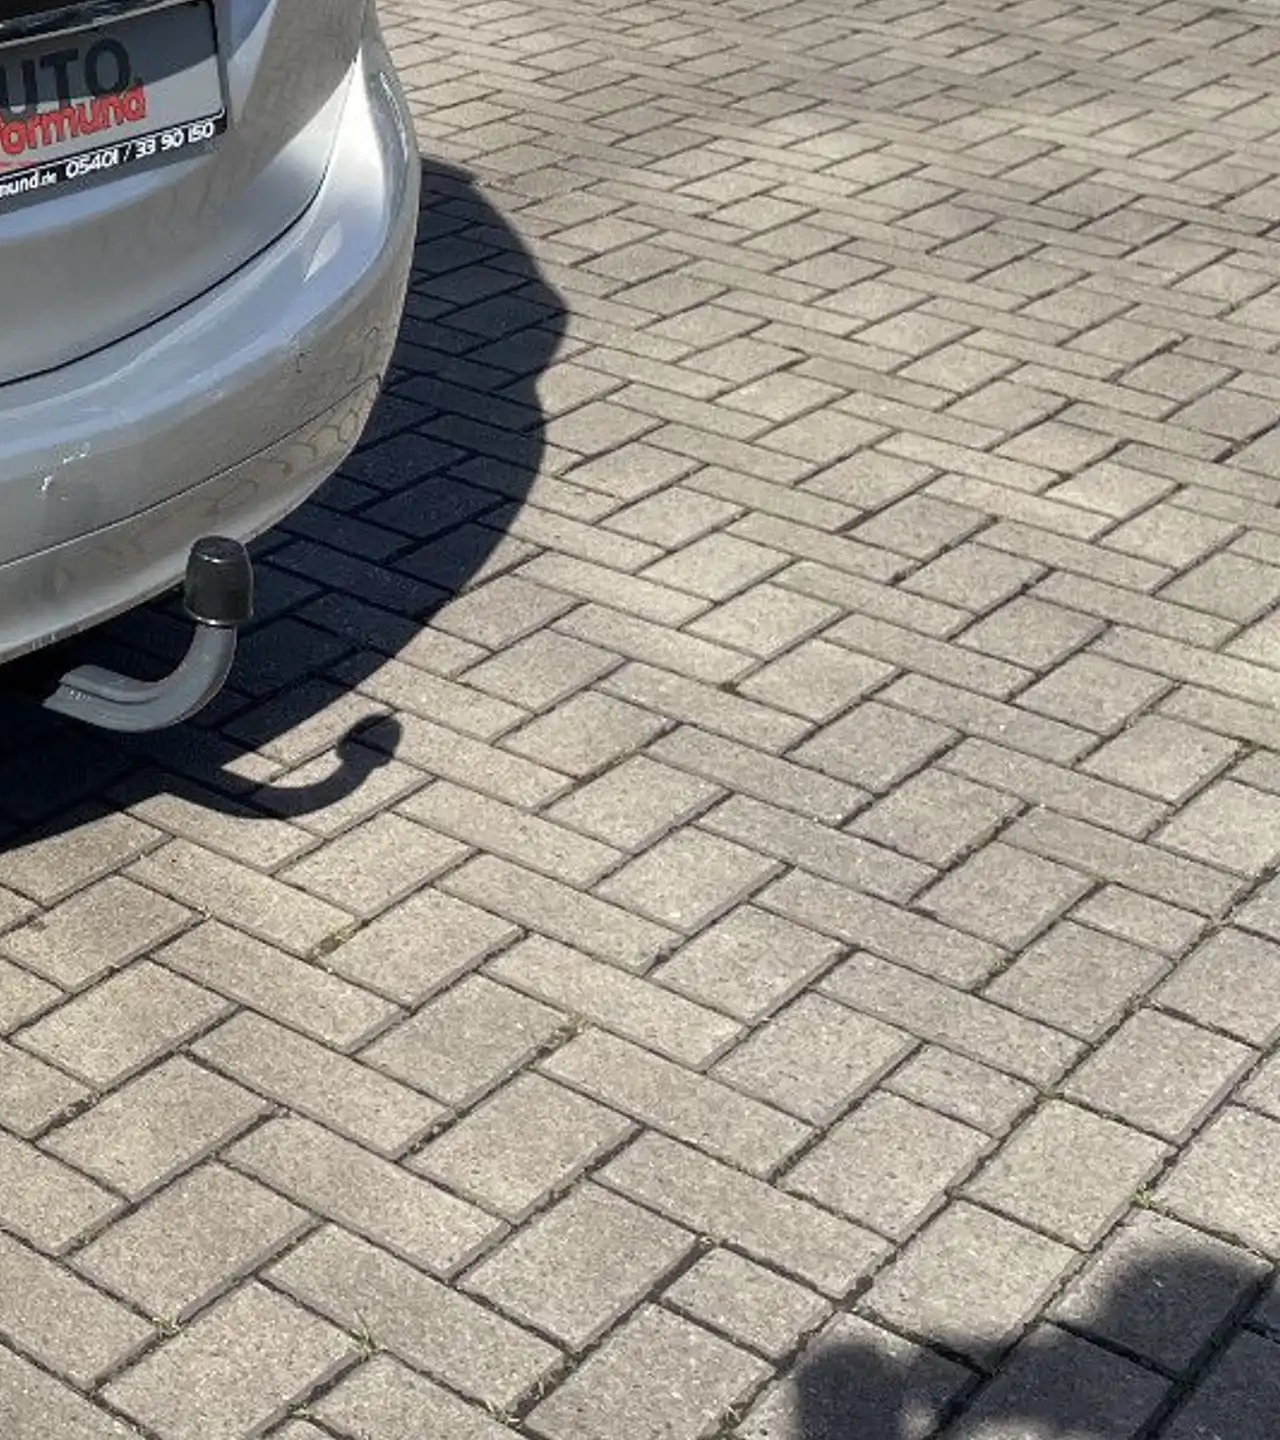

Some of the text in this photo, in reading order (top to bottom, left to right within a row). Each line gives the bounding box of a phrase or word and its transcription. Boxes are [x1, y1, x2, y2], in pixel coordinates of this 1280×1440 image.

[66, 148, 119, 179] 05401
[135, 137, 156, 159] 33
[161, 126, 184, 151] 90
